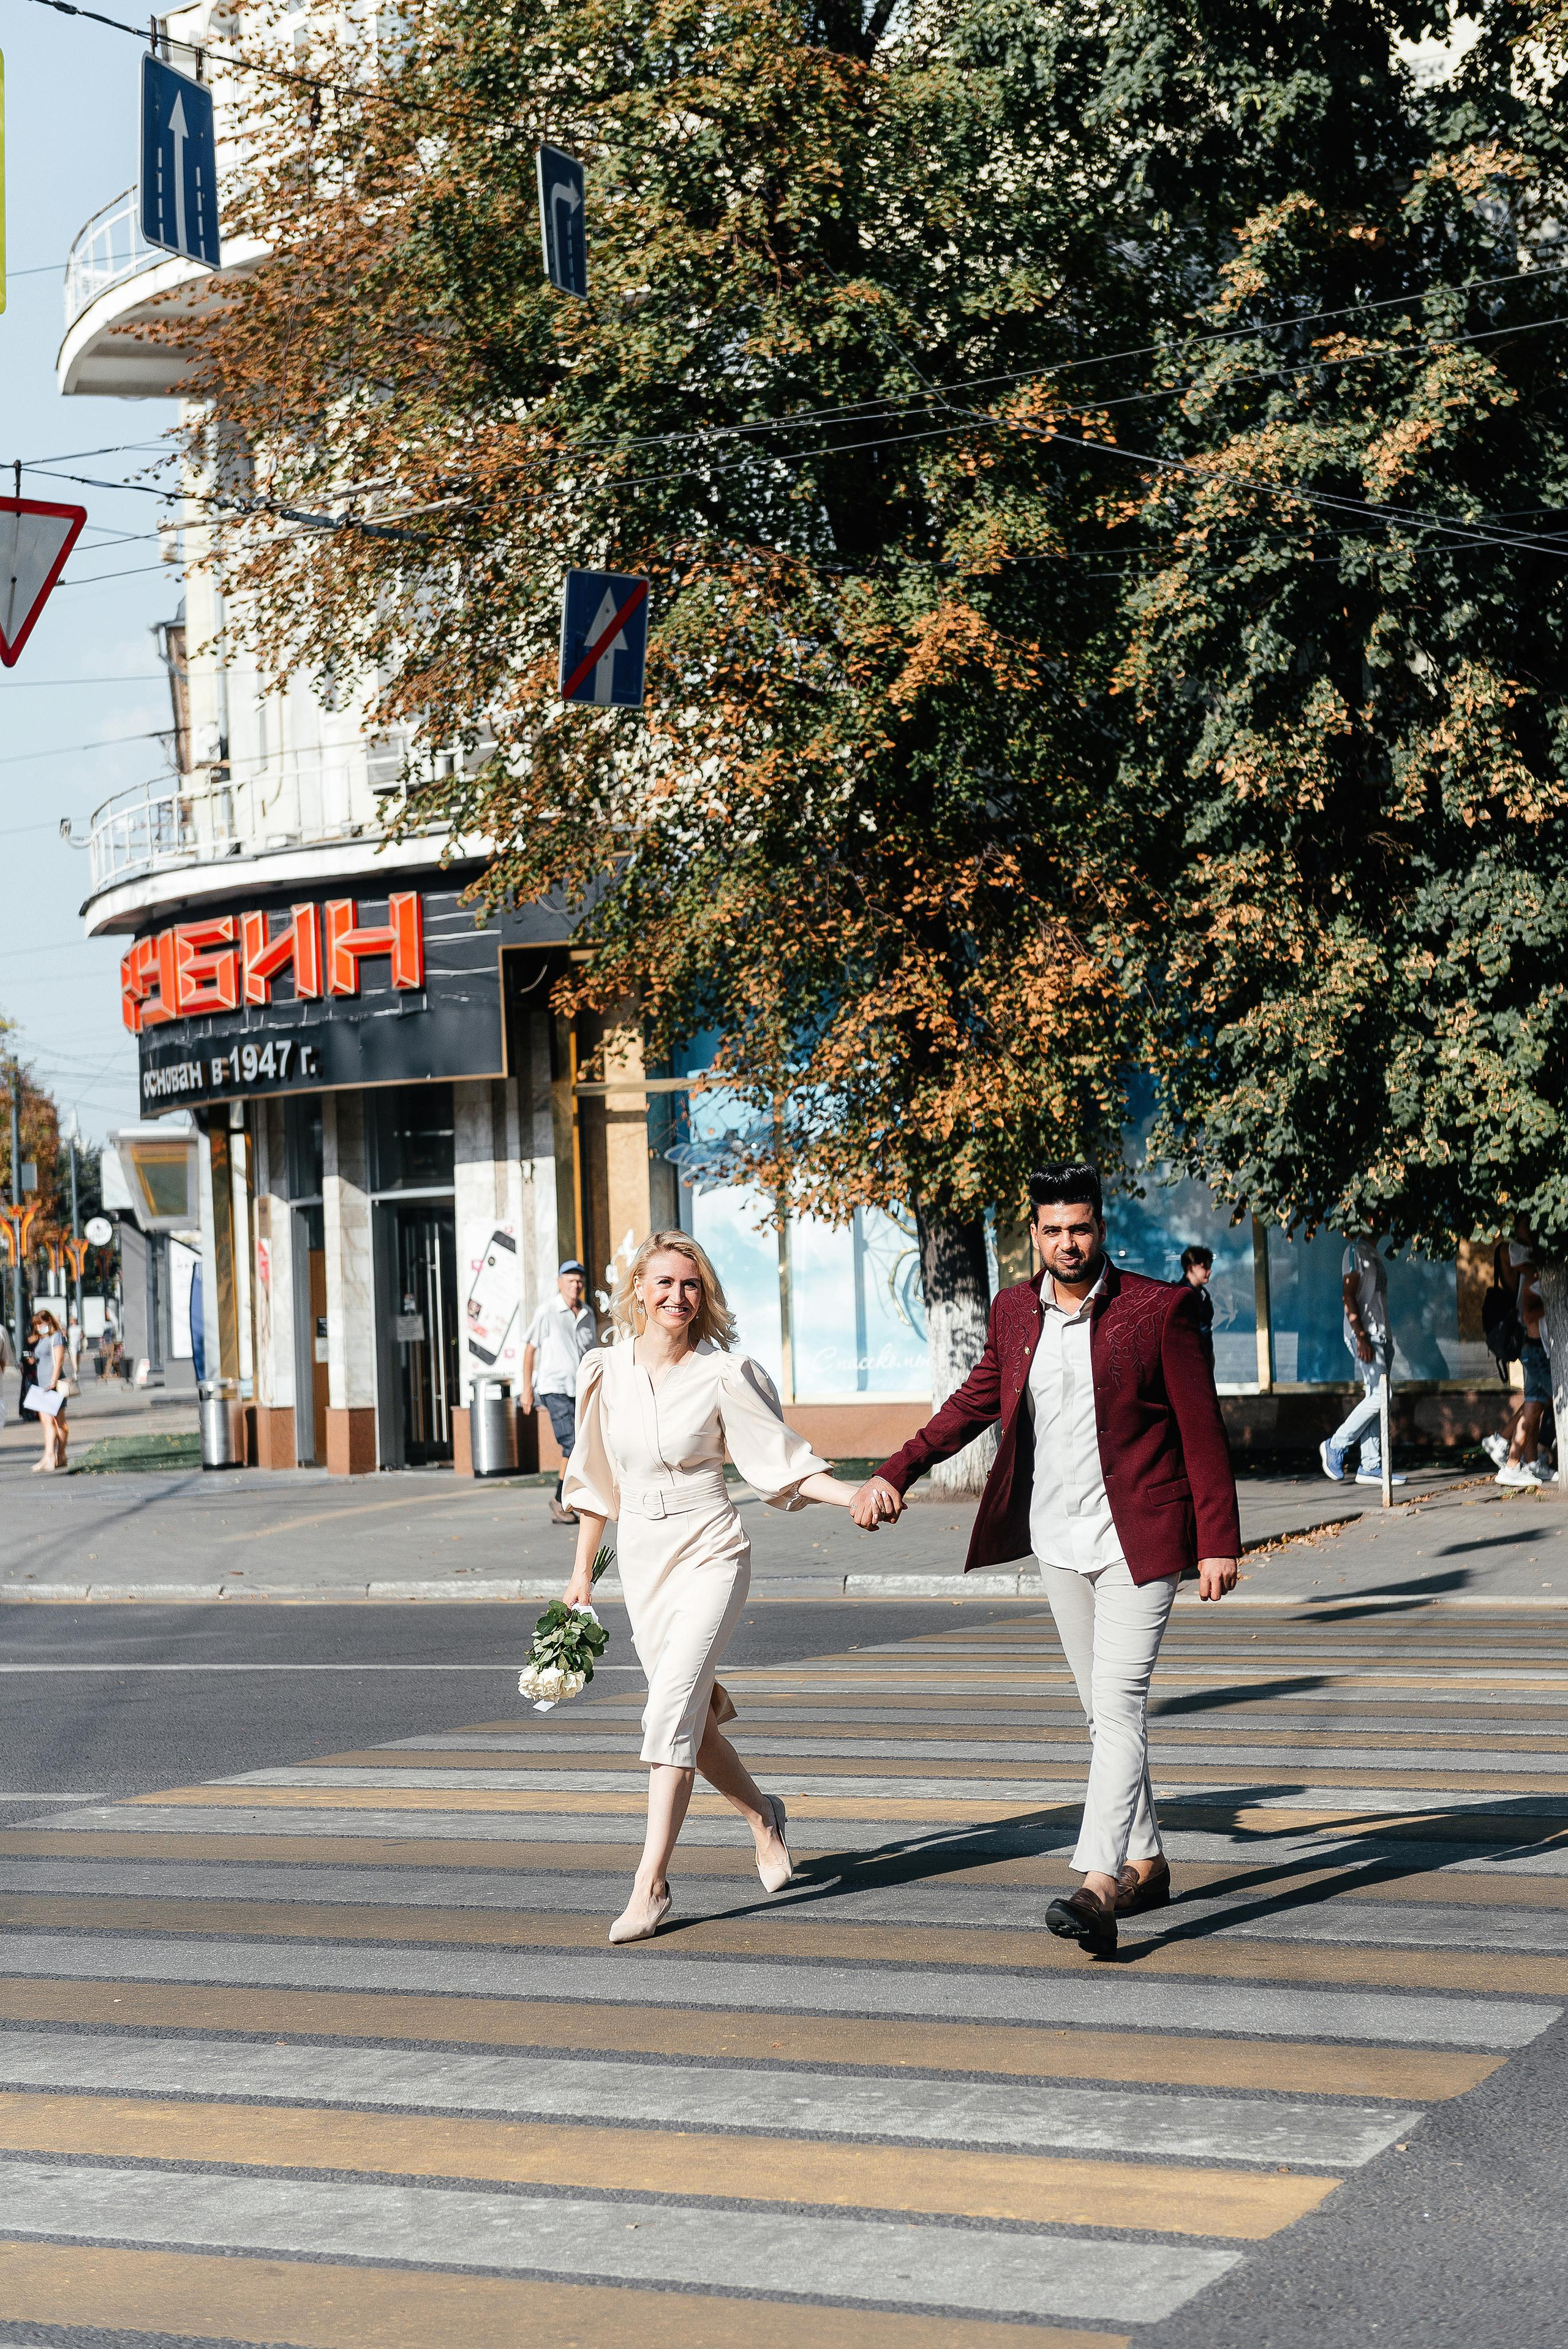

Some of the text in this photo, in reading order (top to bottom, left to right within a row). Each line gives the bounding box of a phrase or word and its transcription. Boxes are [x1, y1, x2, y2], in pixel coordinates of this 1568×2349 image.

[143, 1040, 316, 1099] основан в 1947 г.
